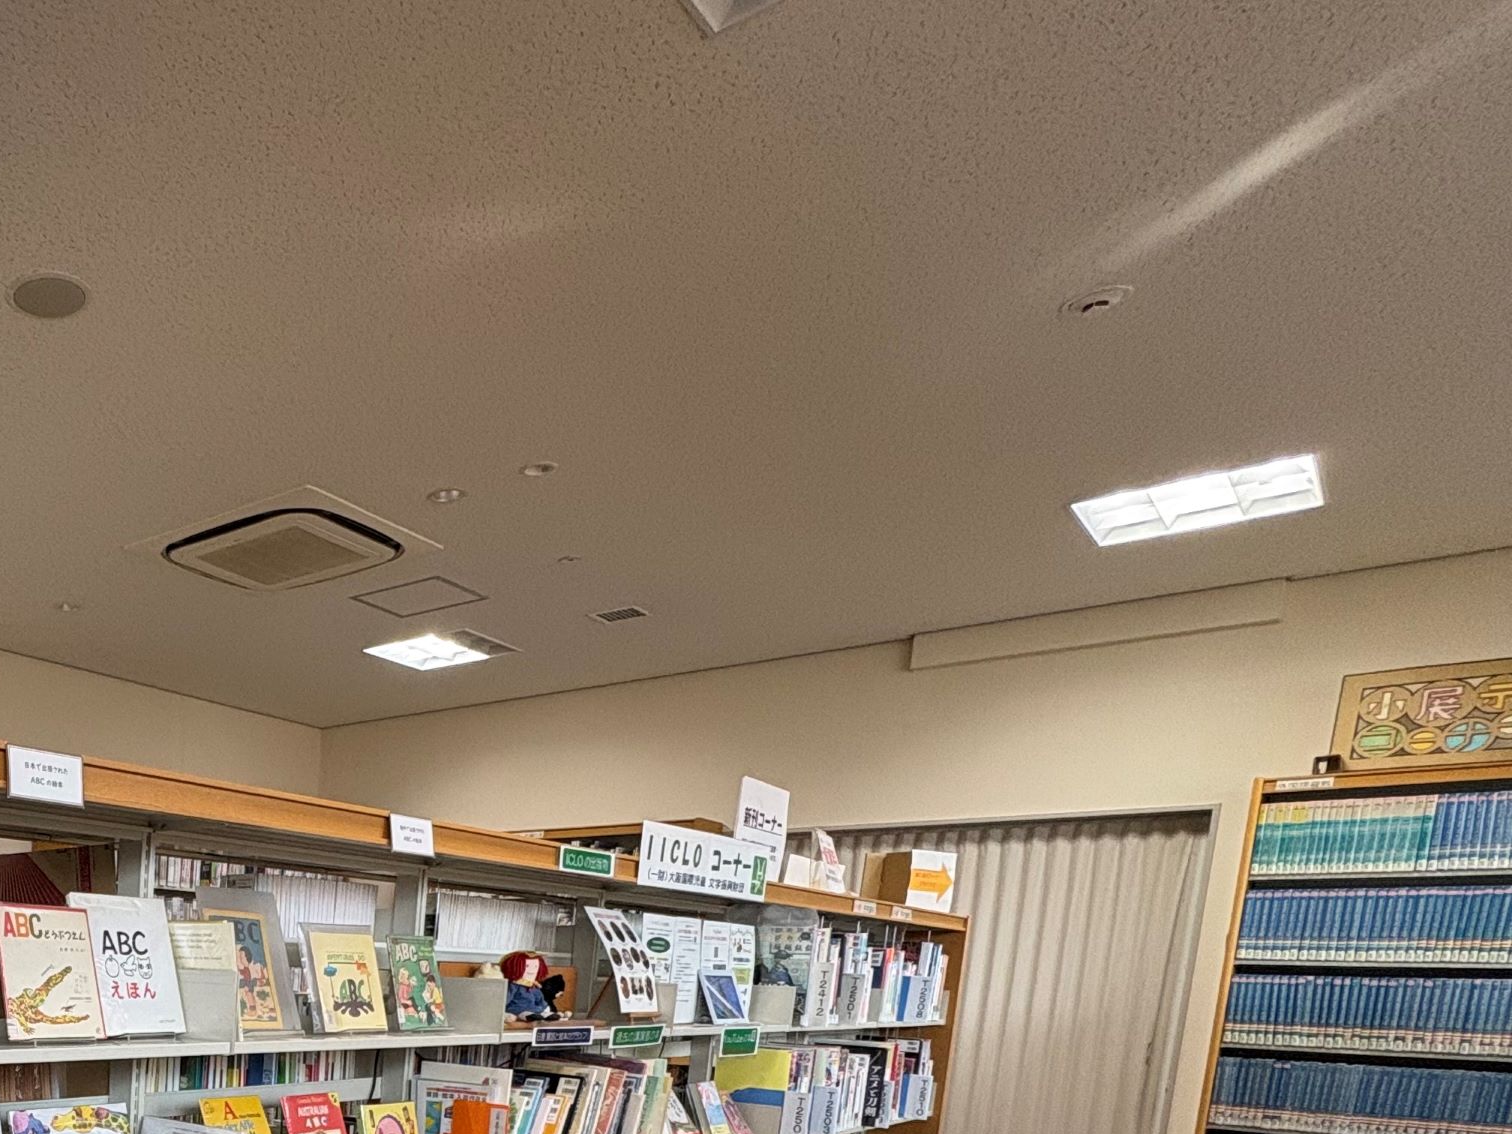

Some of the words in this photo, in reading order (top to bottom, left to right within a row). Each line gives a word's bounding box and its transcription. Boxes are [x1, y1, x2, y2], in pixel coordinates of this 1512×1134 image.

[711, 850, 751, 877] コーナー
[102, 930, 148, 956] ABC
[395, 943, 418, 962] ABC
[111, 981, 156, 1000] えほん
[339, 979, 365, 1001] ABC
